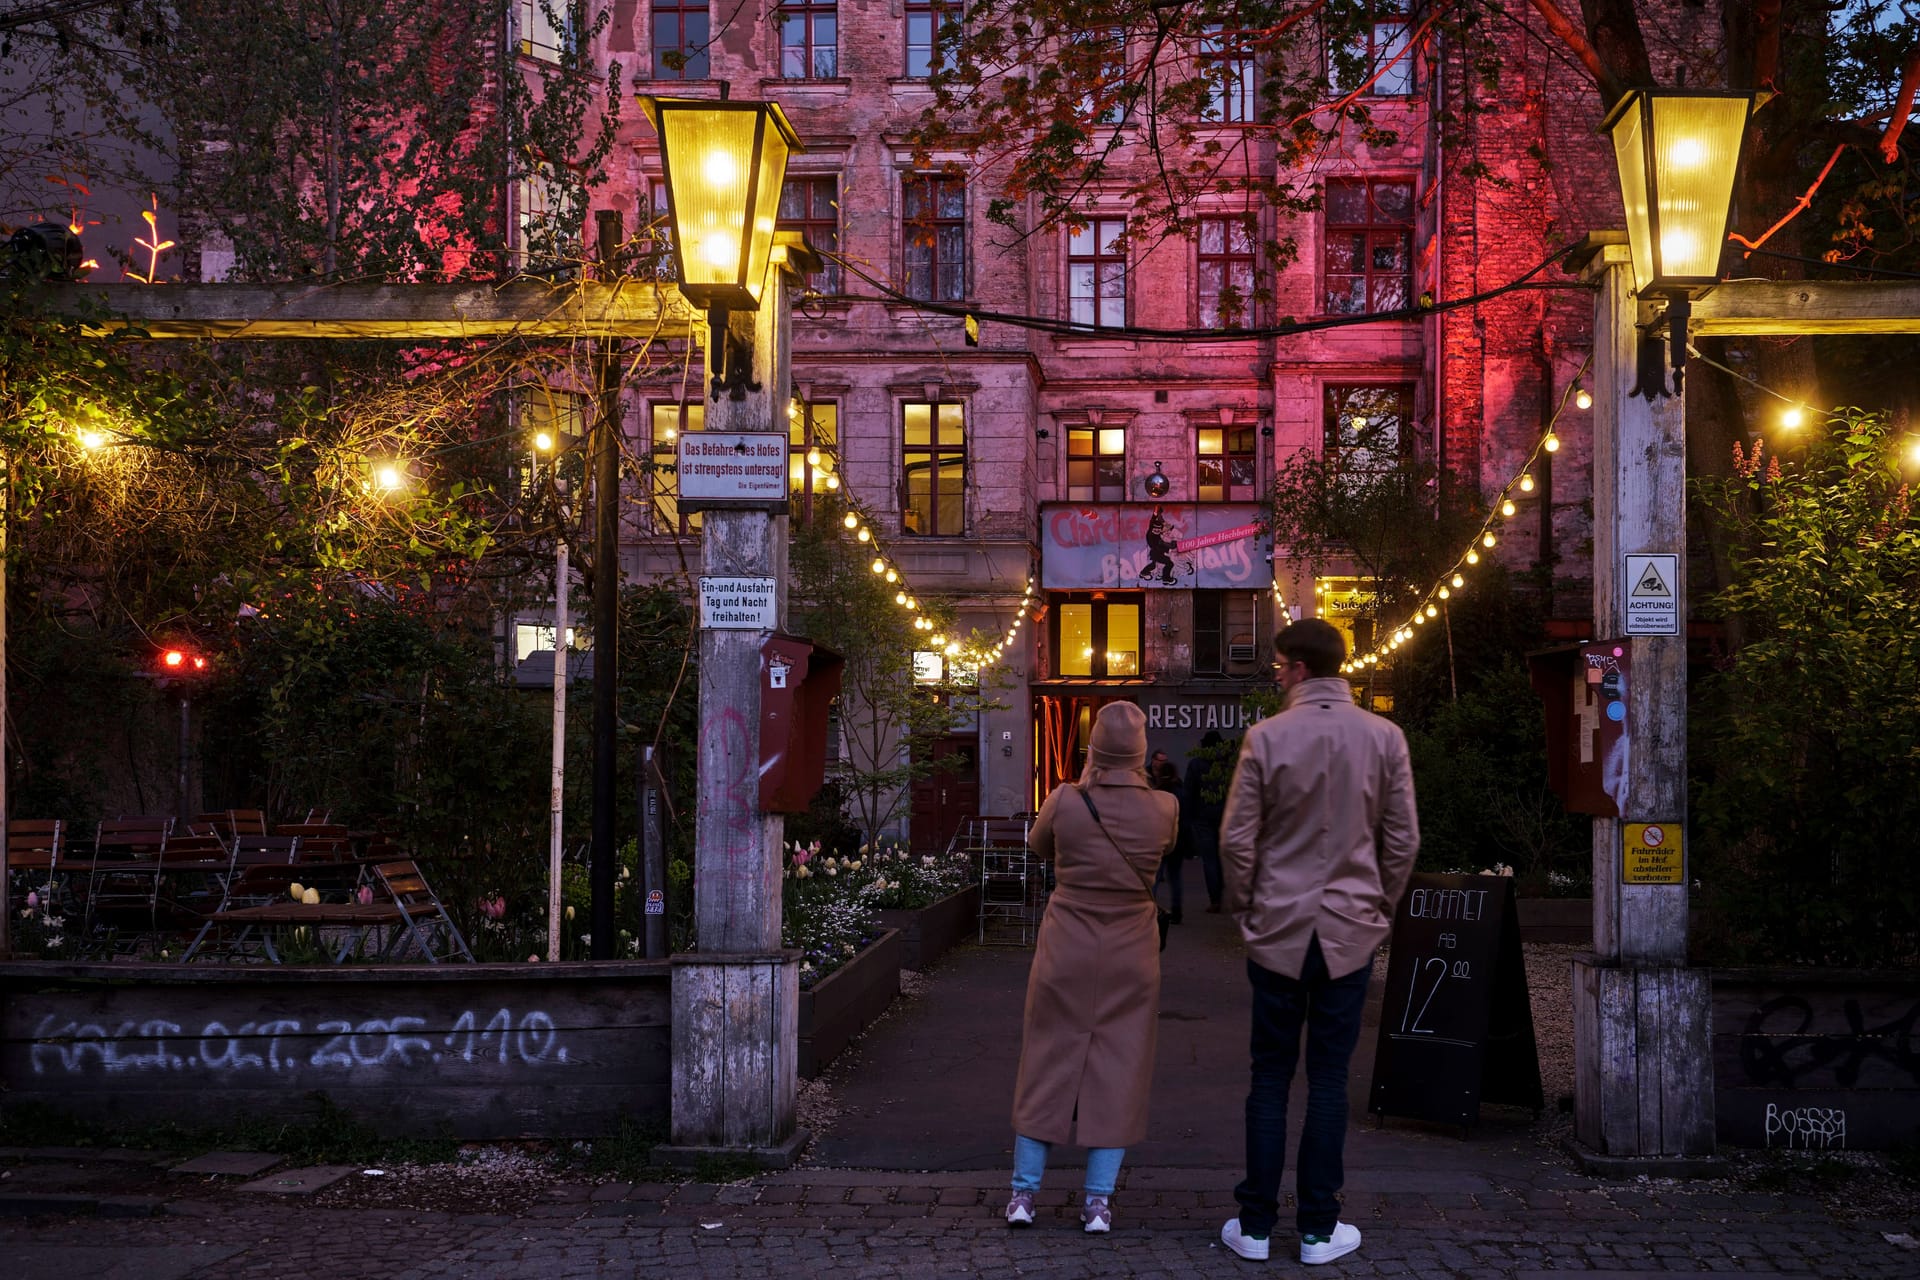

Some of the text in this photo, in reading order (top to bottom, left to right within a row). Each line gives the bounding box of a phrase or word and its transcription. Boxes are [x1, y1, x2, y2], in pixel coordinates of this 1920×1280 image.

[685, 442, 700, 456] Das
[742, 444, 755, 457] es
[757, 444, 780, 457] Hofes
[682, 462, 783, 479] ist strengstens untersagt
[1181, 526, 1262, 549] 100 Jahre Hochbetrie
[736, 582, 774, 594] Ausfahrt
[706, 596, 767, 609] Tag und Nacht
[1629, 601, 1674, 610] ACHTUNG!
[1635, 616, 1654, 624] Objekt
[1631, 847, 1676, 856] Fahrräder
[1638, 856, 1668, 864] im Hof
[1632, 865, 1672, 873] abstellen
[1438, 932, 1457, 949] AB
